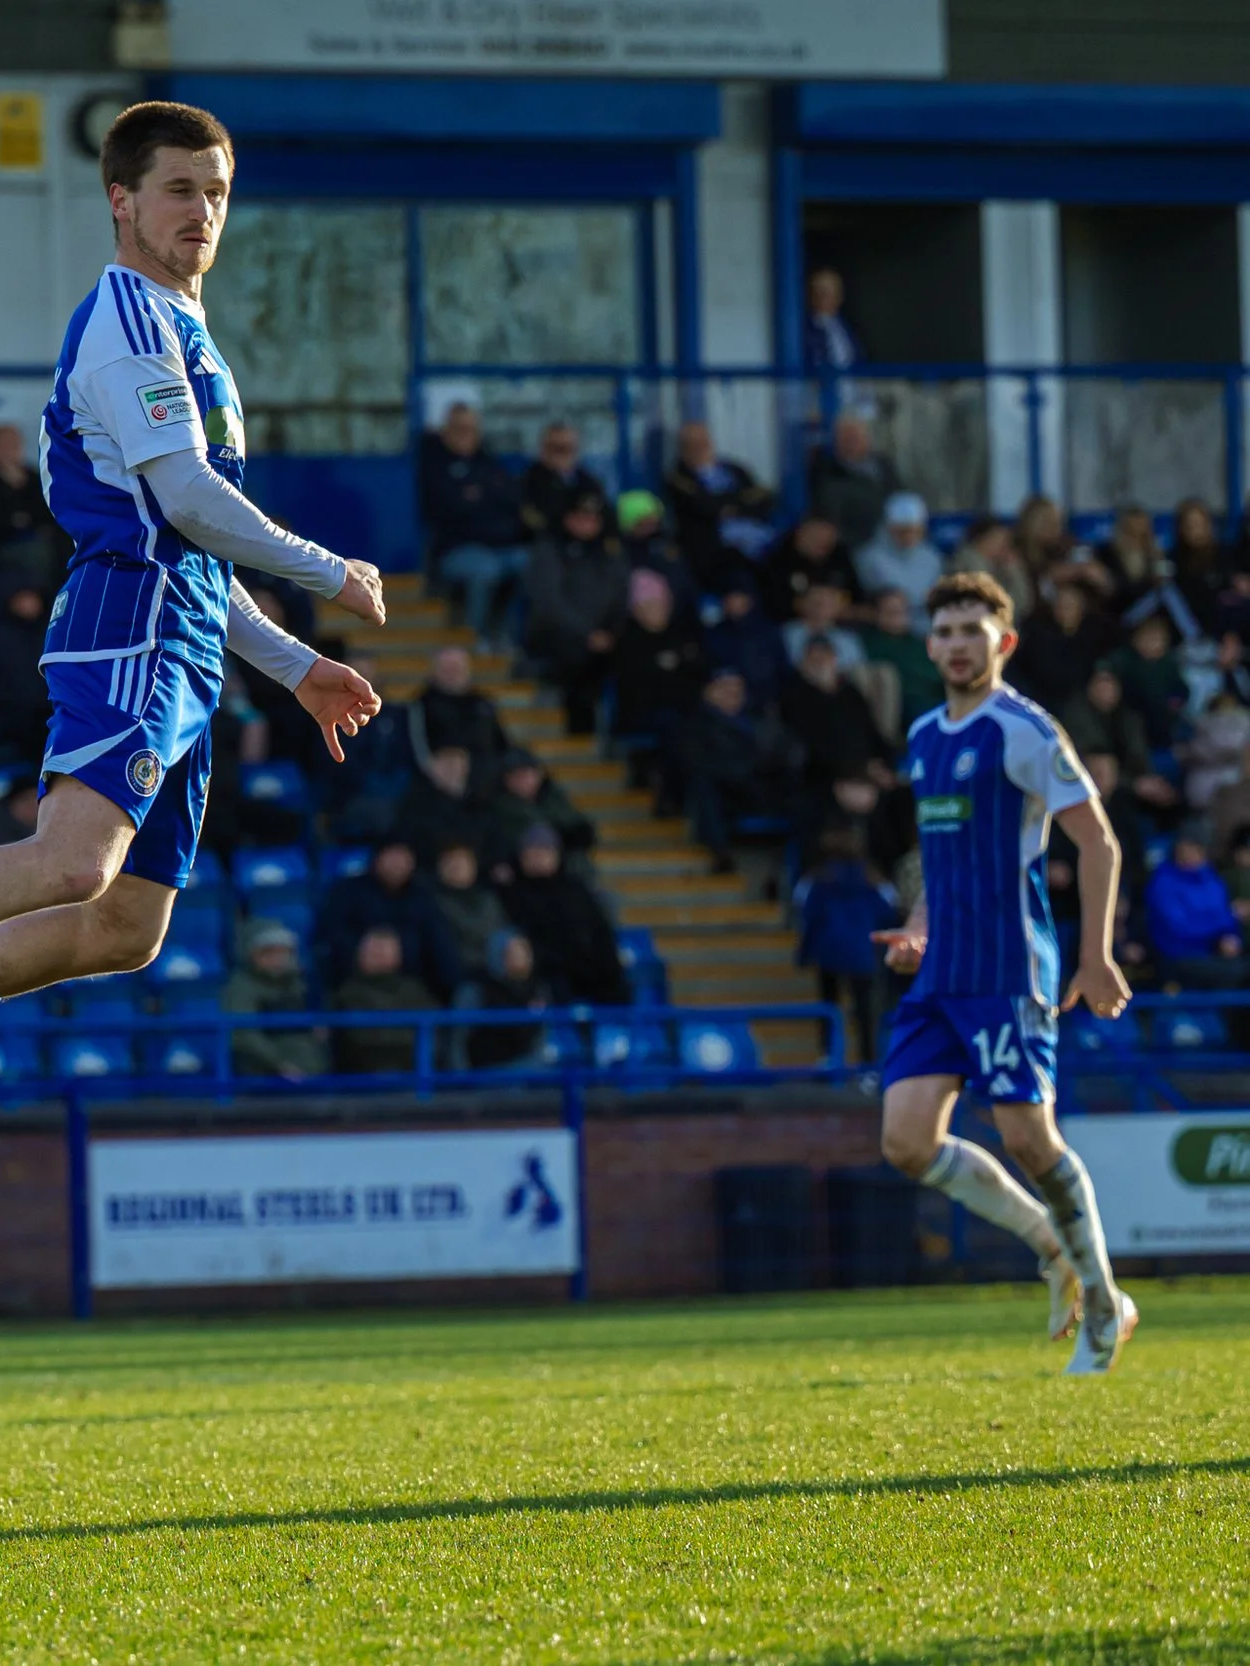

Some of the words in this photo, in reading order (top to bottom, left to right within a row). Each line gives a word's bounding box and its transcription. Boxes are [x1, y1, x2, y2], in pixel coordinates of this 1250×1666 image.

[972, 1022, 1020, 1075] 14
[106, 1192, 244, 1228] REGIONAL
[253, 1188, 356, 1225] STEELS
